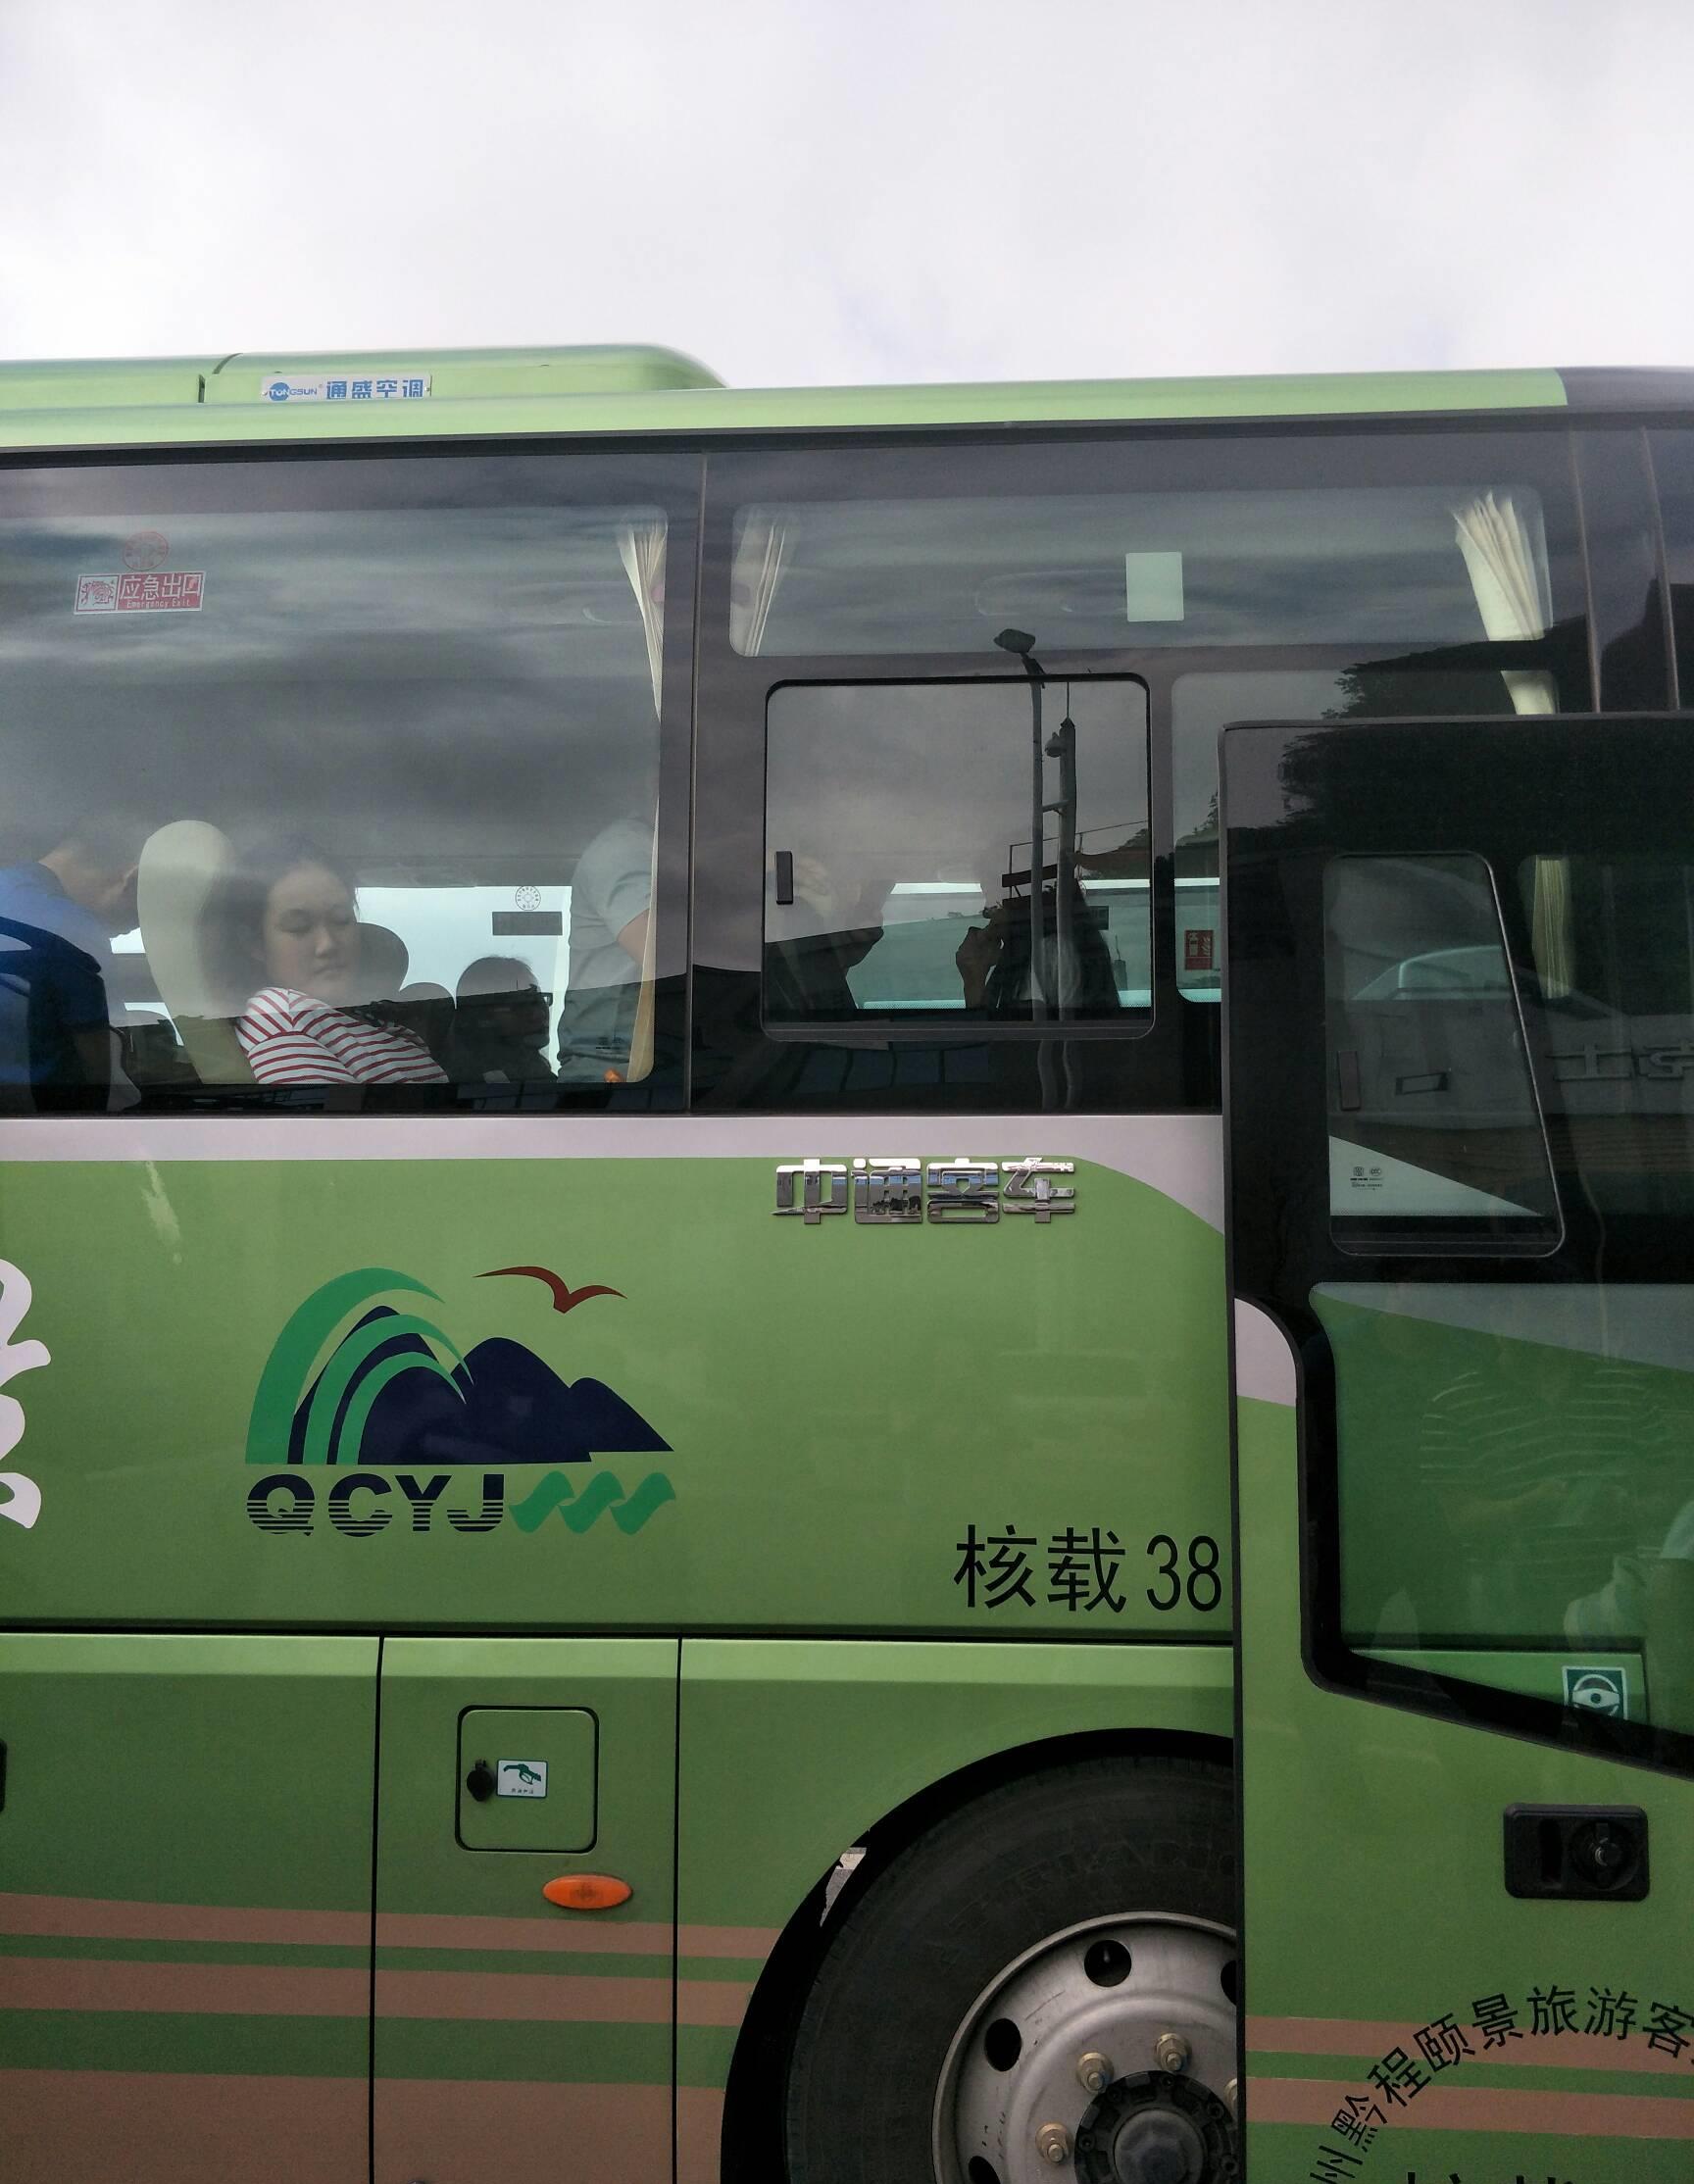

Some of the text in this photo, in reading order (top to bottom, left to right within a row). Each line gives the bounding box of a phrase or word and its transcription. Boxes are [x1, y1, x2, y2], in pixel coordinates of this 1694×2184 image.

[326, 379, 424, 399] 通盛空调
[119, 571, 201, 601] 应急出口
[126, 597, 191, 609] Emergency Exit
[772, 1157, 1075, 1224] 中通客车
[246, 1472, 505, 1537] QCYJ
[954, 1524, 1221, 1613] 核载 38
[1310, 1985, 1694, 2184] 州黔程颐景旅游客
